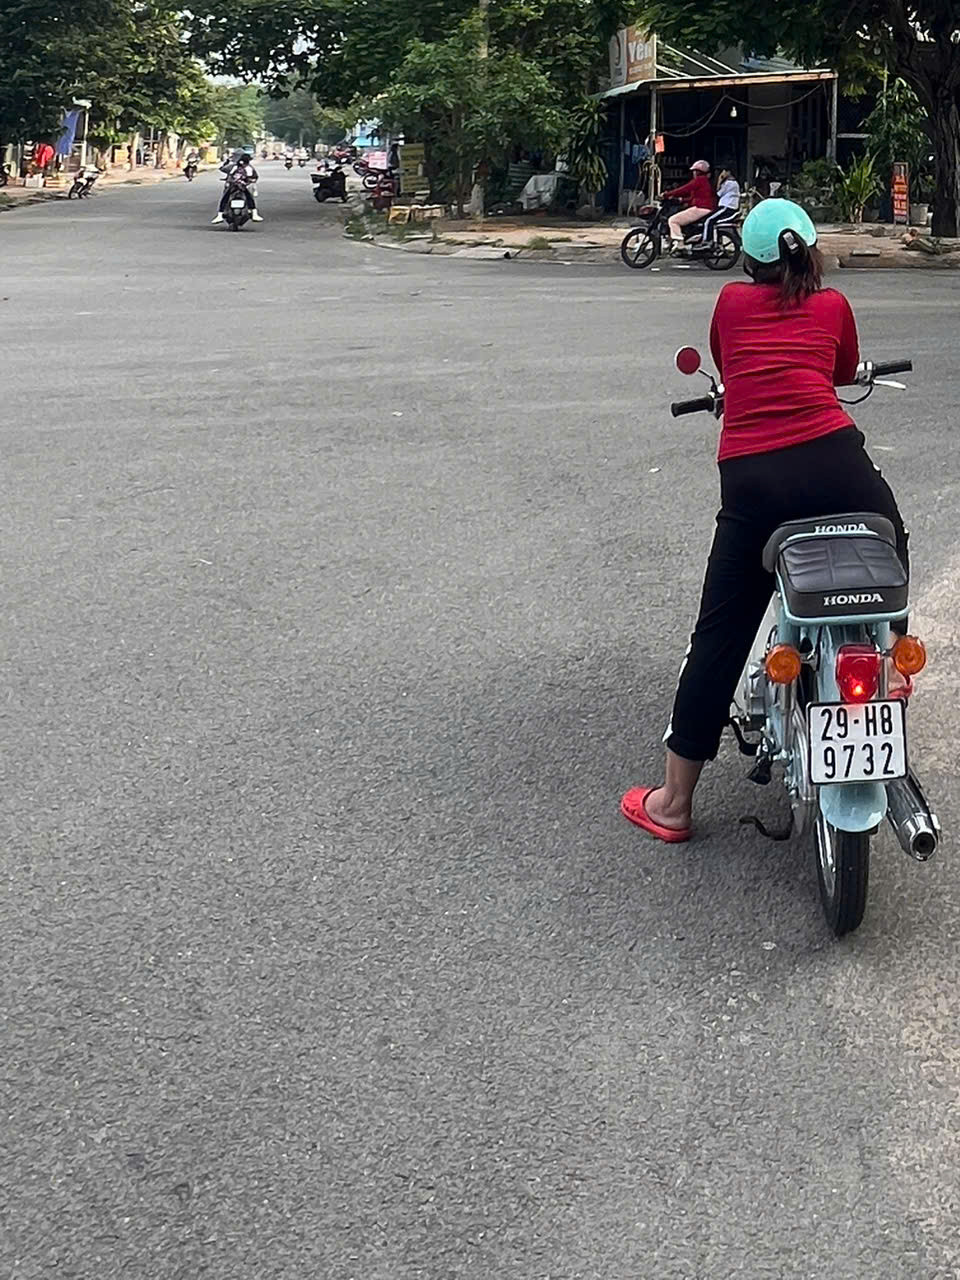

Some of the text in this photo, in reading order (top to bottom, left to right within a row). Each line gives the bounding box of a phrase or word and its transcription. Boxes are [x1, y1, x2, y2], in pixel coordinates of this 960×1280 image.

[814, 523, 868, 533] HONDA
[823, 593, 884, 606] HONDA
[824, 742, 895, 779] 9732
